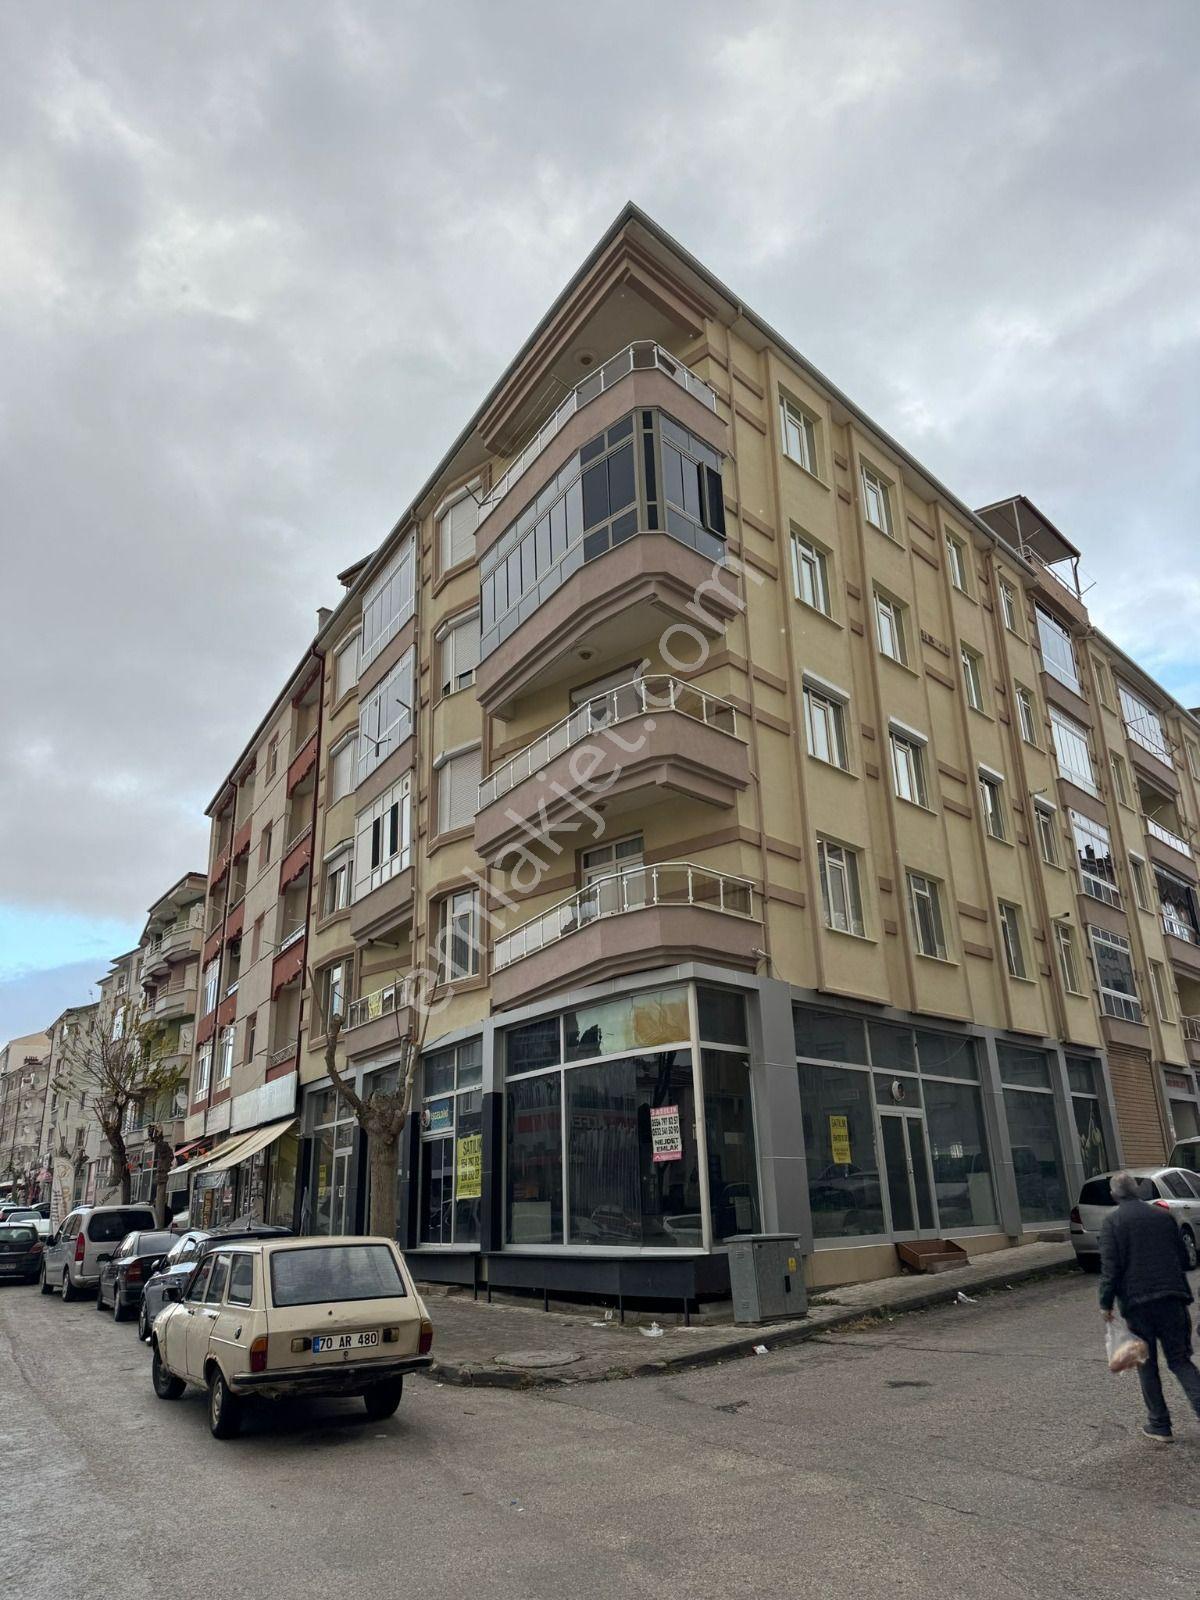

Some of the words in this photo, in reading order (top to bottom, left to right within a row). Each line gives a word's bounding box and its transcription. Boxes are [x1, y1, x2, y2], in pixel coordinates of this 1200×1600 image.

[654, 1137, 679, 1146] NEJDET
[656, 1144, 679, 1152] EMLAK
[320, 1337, 333, 1350] 70
[339, 1335, 352, 1348] AR
[358, 1332, 377, 1346] 480
